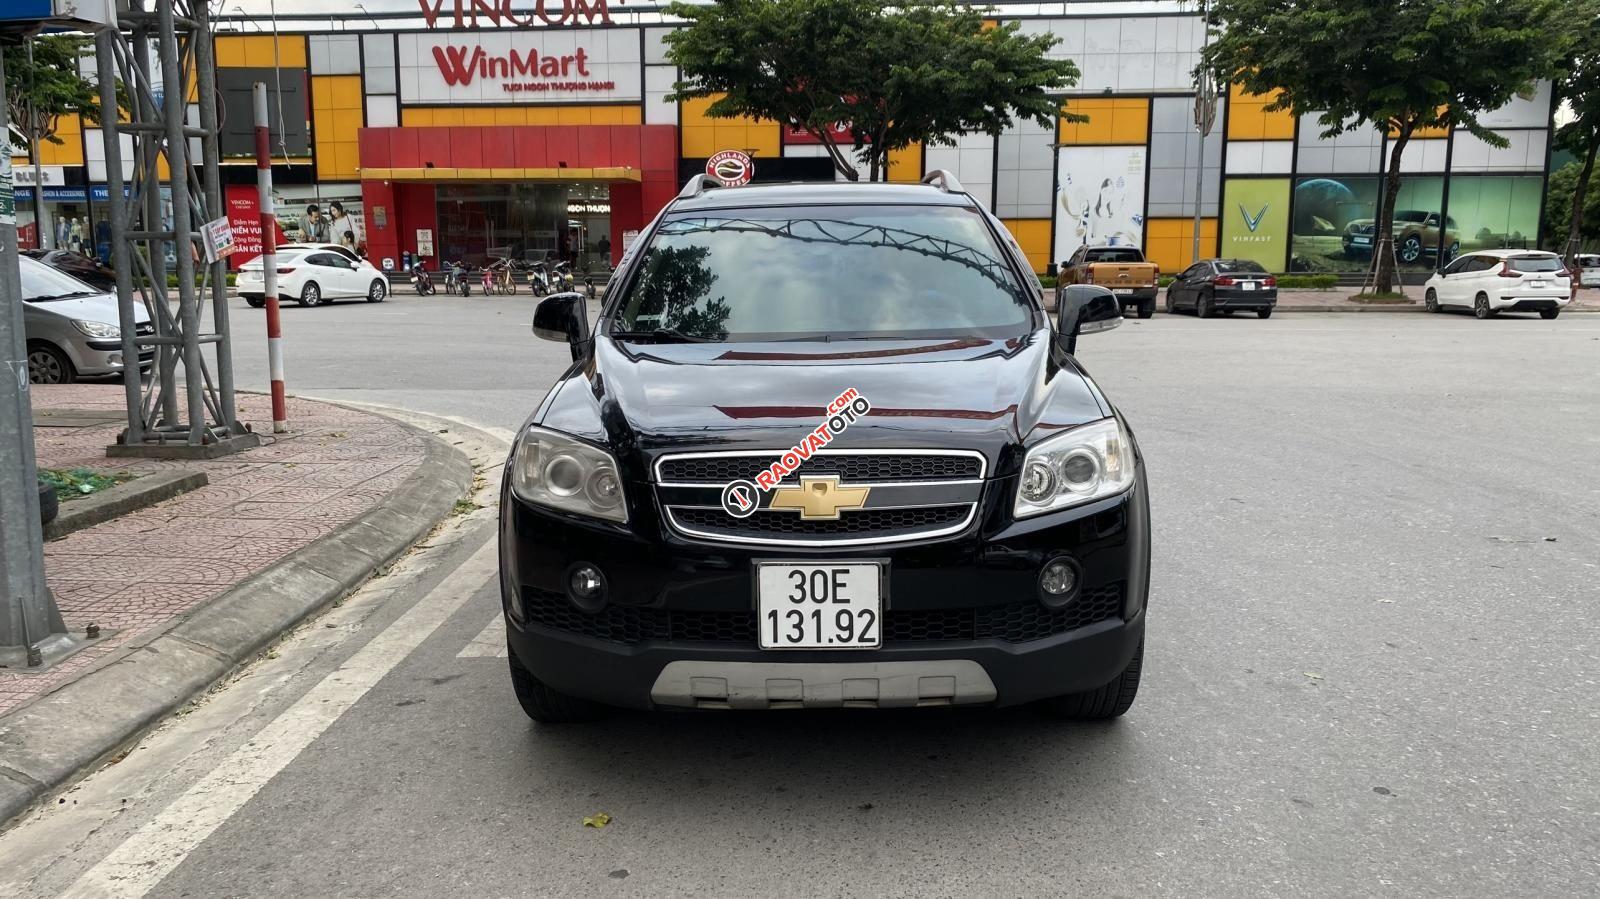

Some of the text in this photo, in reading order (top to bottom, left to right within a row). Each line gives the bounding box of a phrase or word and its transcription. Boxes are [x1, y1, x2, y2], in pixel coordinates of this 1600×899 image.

[418, 0, 615, 28] VINCOM
[431, 45, 590, 86] WinMart
[15, 171, 49, 183] BLUS
[249, 227, 262, 235] VUI
[788, 569, 850, 604] 30E
[768, 609, 876, 643] 131.92
